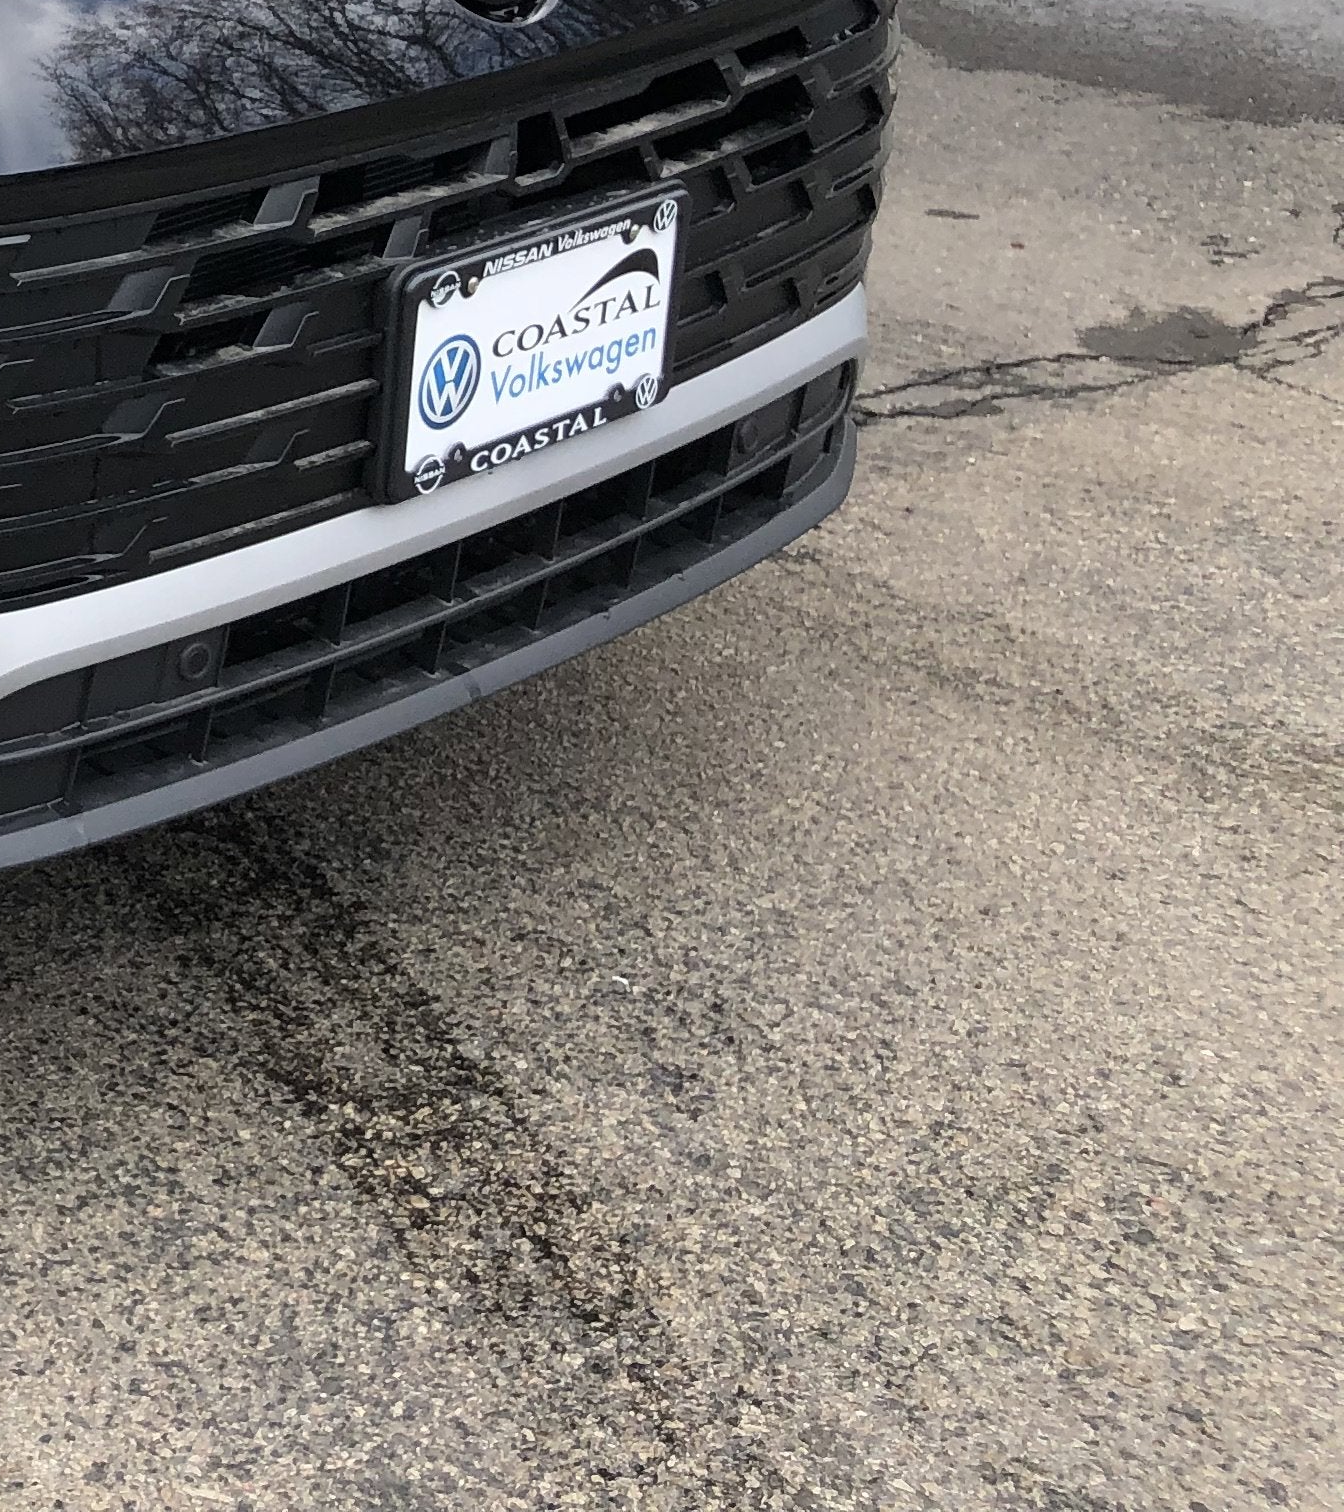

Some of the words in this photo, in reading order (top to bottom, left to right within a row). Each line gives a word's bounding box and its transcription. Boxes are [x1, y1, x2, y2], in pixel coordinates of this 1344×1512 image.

[482, 243, 553, 277] NISSAN
[555, 218, 632, 253] Volkswagen
[492, 284, 661, 359] COASTAL
[490, 327, 657, 405] Volkswagen
[469, 406, 608, 473] COASTAL
